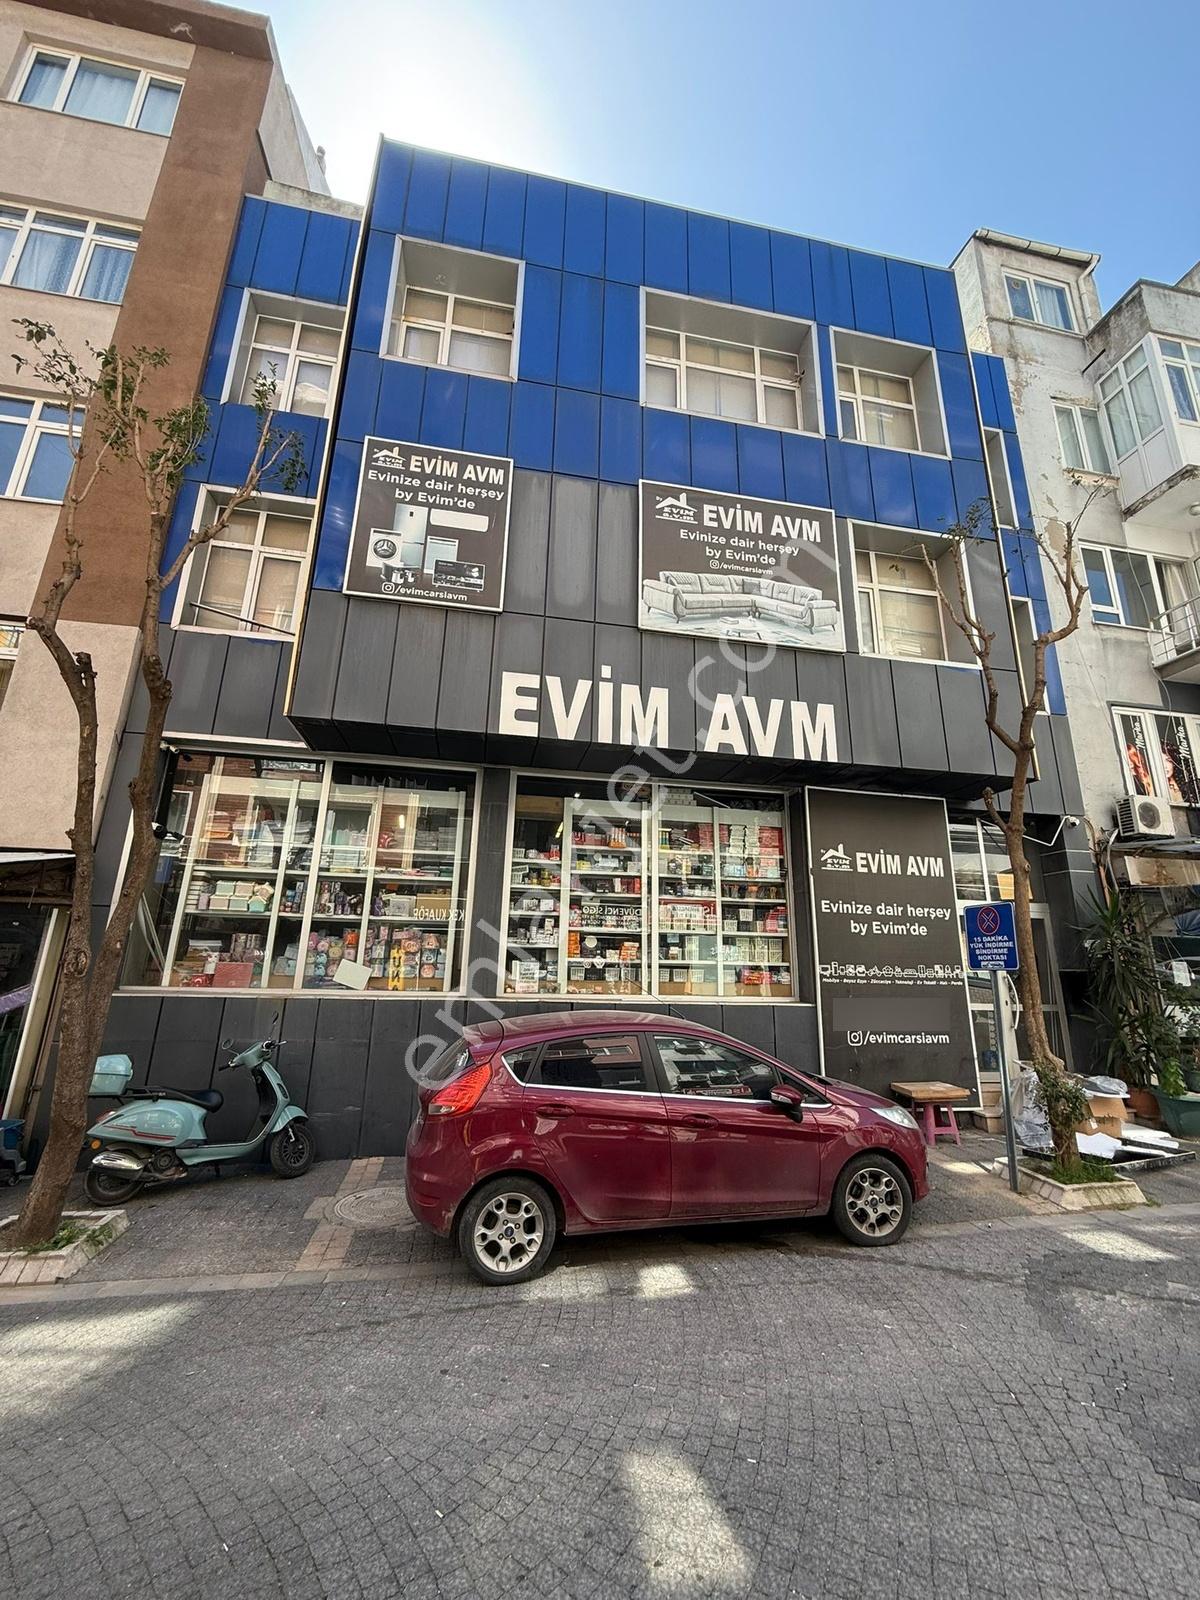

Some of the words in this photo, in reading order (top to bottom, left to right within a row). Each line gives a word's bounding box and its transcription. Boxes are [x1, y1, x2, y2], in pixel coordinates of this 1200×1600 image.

[409, 455, 459, 478] EVİM
[463, 464, 505, 485] AVM
[367, 469, 421, 487] Evinize
[425, 479, 454, 492] dair
[457, 483, 505, 501] herşey
[395, 488, 413, 501] by
[703, 503, 763, 534] EVİM
[770, 514, 822, 543] AVM
[680, 529, 727, 545] Evinize
[730, 536, 755, 549] dair
[758, 540, 799, 556] herşey
[705, 546, 722, 559] by
[498, 664, 669, 749] EVİM
[703, 693, 839, 762] AVM
[1177, 726, 1191, 759] Marka
[855, 849, 902, 875] EVİM
[906, 855, 945, 877] AVM
[821, 899, 873, 915] Evinize
[876, 902, 904, 917] dair
[906, 904, 951, 920] herşey
[850, 920, 868, 936] by
